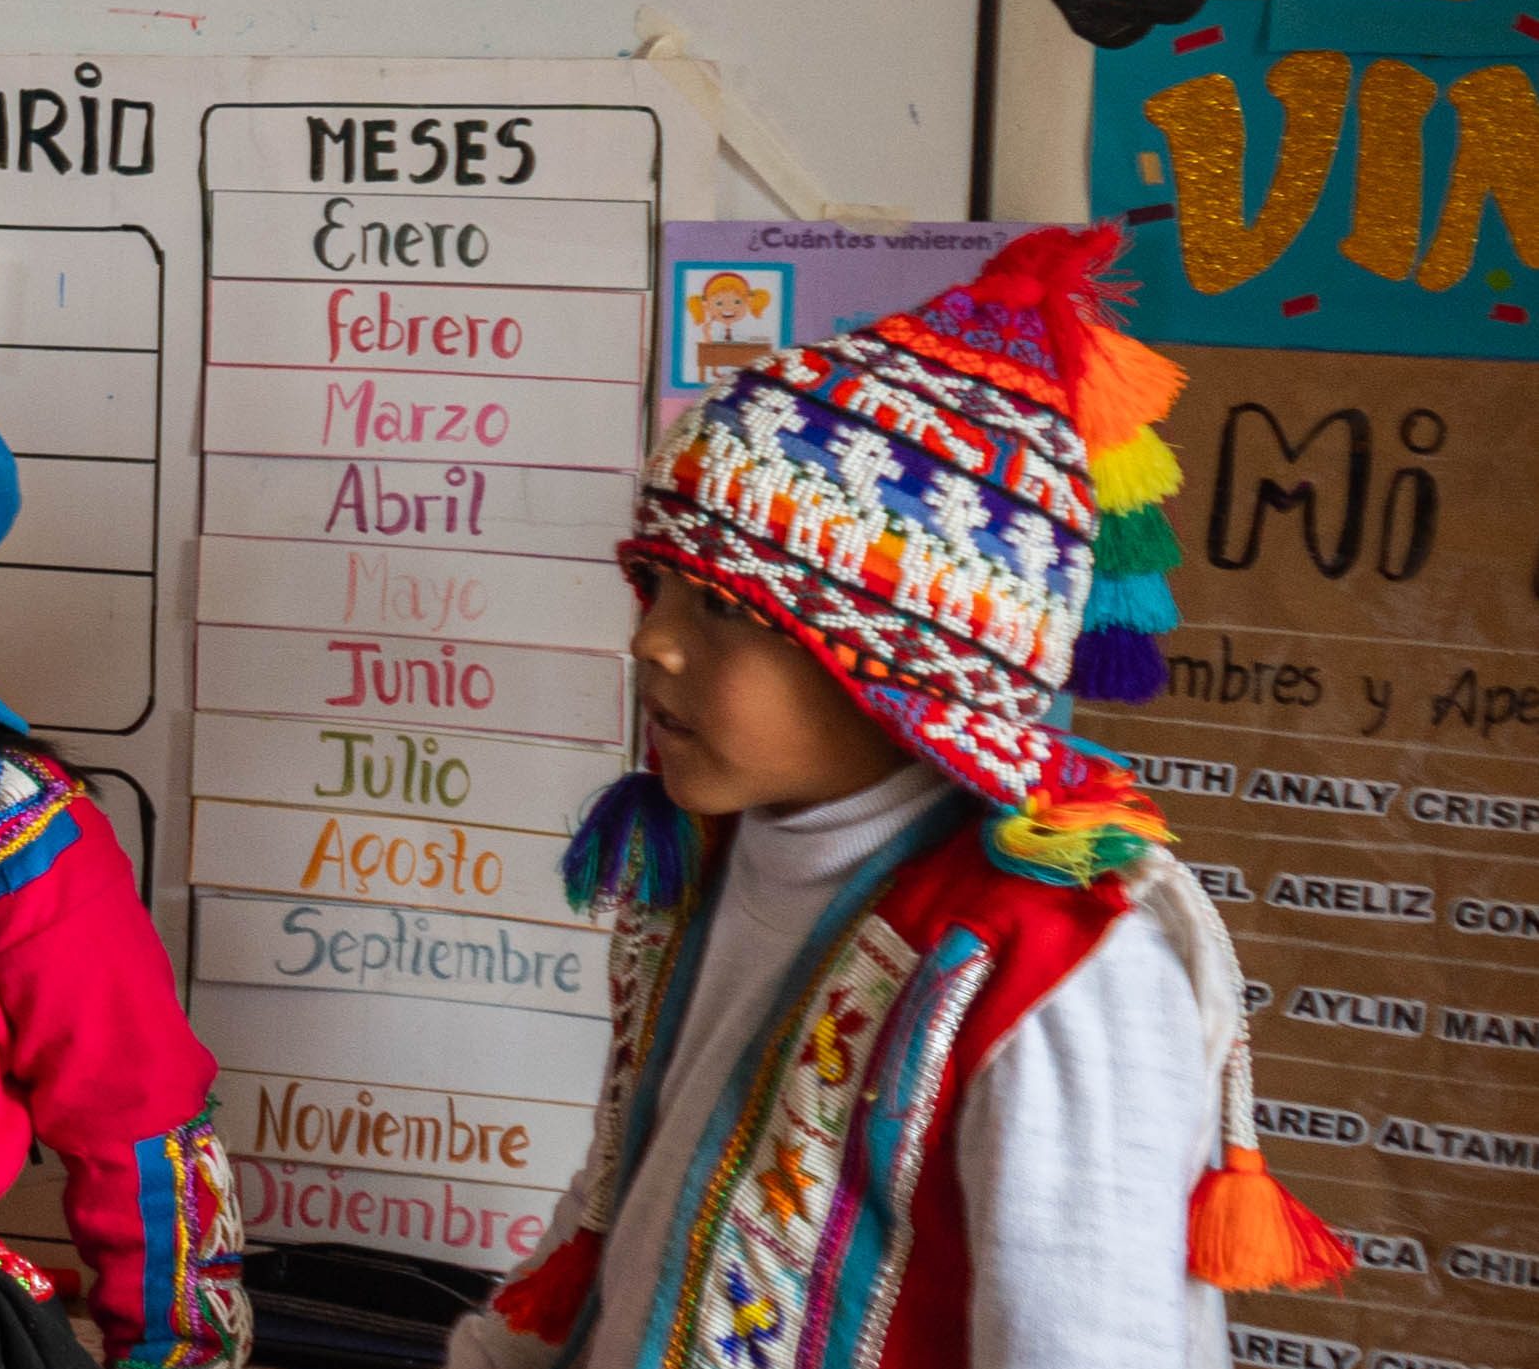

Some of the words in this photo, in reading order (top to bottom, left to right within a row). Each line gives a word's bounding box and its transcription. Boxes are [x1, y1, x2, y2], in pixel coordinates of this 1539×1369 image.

[308, 117, 537, 186] MESES
[313, 197, 489, 274] Enero
[322, 379, 510, 448] Marzo
[325, 464, 485, 537] Abril
[343, 552, 487, 631] Mayo
[325, 641, 494, 709] Junio
[1166, 635, 1323, 707] mbres
[1362, 675, 1389, 734] y
[315, 730, 470, 808] Julio
[1248, 769, 1397, 815] ANALY
[300, 818, 502, 895] Agosto
[1190, 865, 1252, 901] EL
[1275, 875, 1435, 921] ARELIZ
[275, 907, 580, 995] Septiembre
[1292, 989, 1424, 1034] AYLIN
[255, 1081, 530, 1169] Noviembre
[1253, 1103, 1368, 1144] ARED
[233, 1155, 545, 1256] Diciembre
